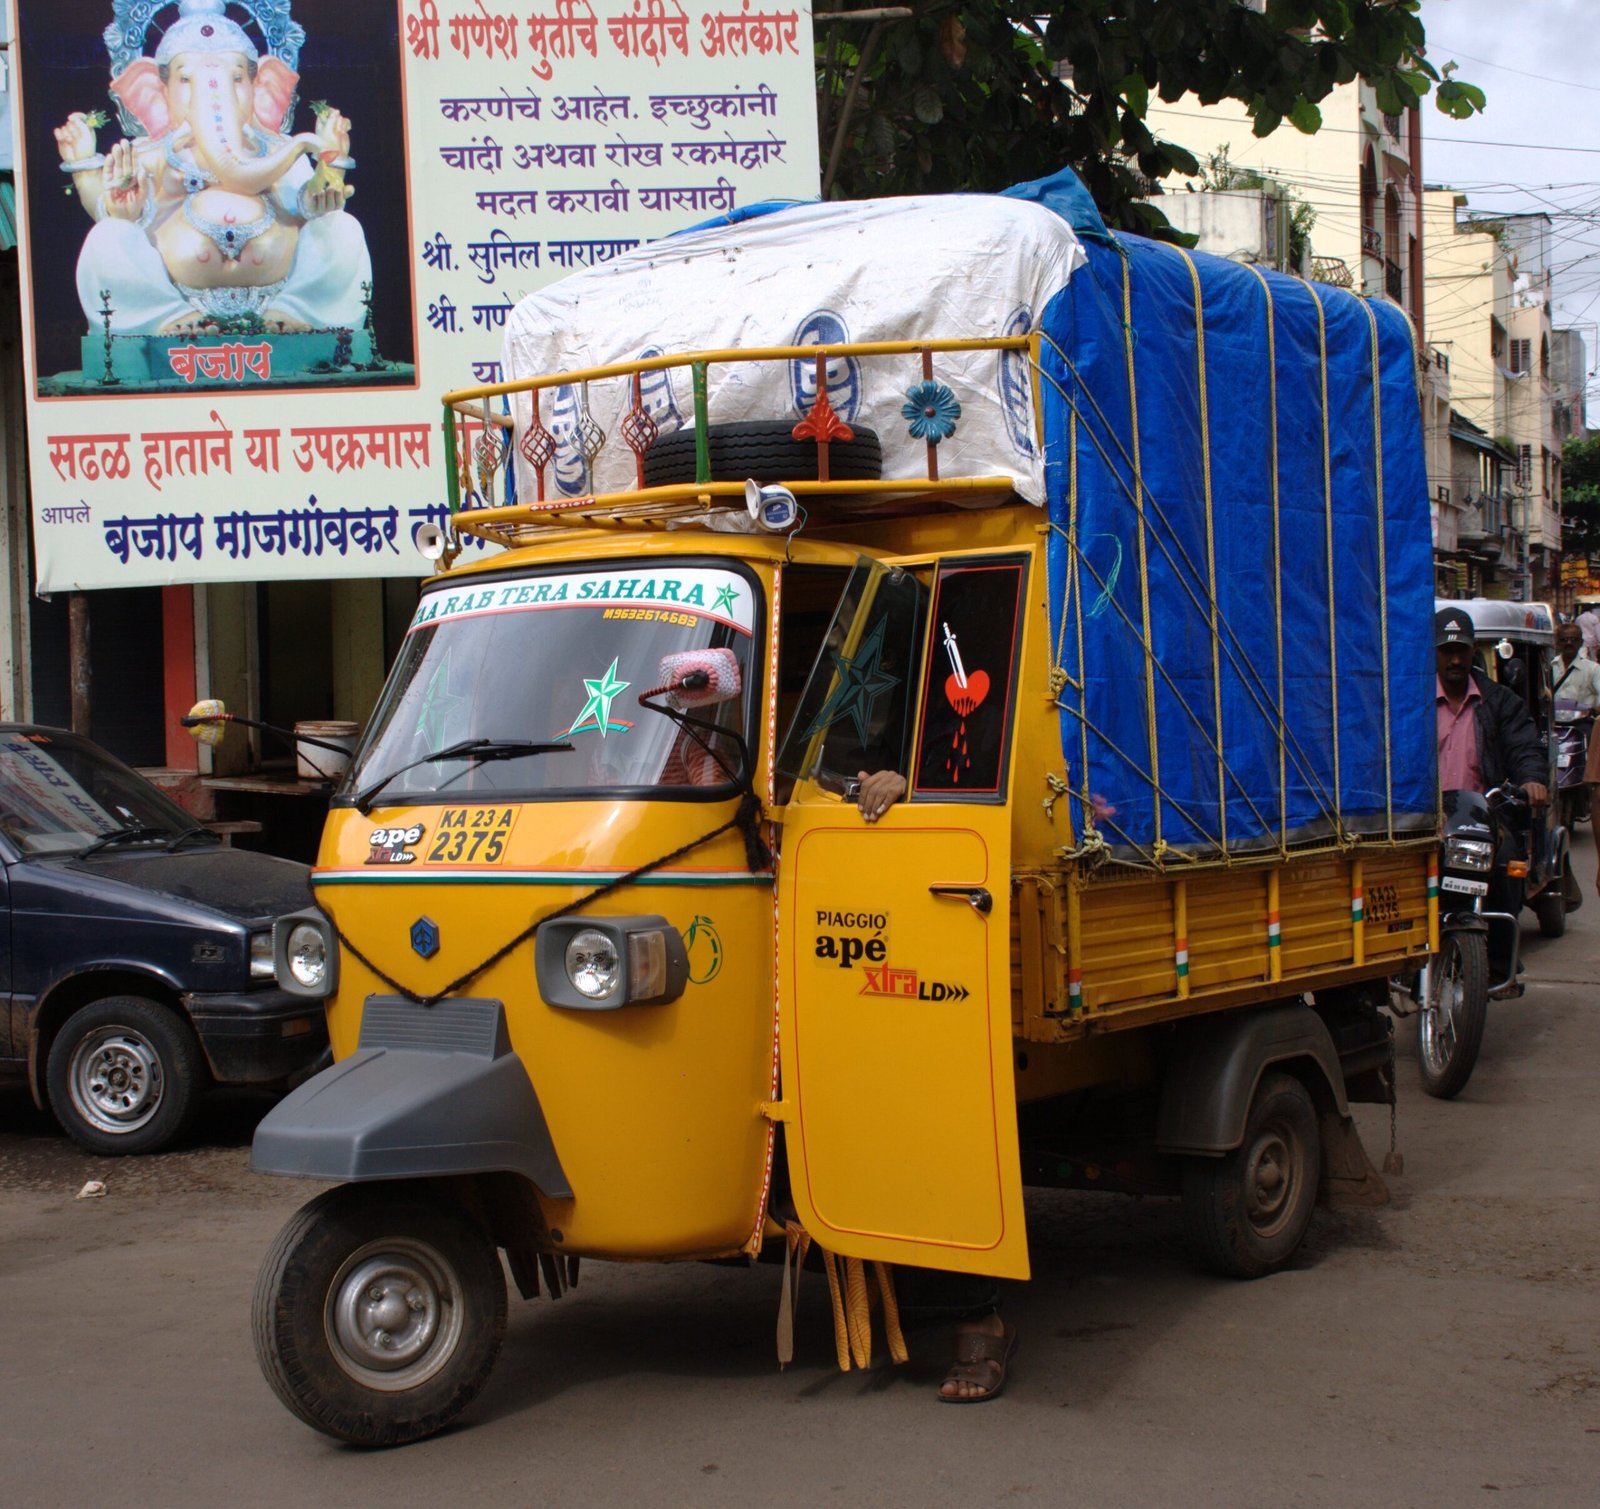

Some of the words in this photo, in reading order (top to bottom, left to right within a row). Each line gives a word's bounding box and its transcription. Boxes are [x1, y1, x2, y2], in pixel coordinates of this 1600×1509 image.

[407, 0, 439, 59] श्री
[449, 0, 518, 60] गणेश
[701, 0, 799, 57] अलंकार
[440, 87, 541, 121] करणेचे
[552, 86, 638, 123] आहेत.
[649, 83, 777, 130] इच्छुकांनी
[440, 136, 503, 174] चांदी
[513, 144, 596, 169] अथवा
[605, 133, 663, 167] रोख
[671, 126, 786, 169] रकमेद्वारे
[476, 191, 538, 219] मदत
[546, 179, 630, 213] करावी
[638, 177, 736, 212] यासाठी
[422, 232, 459, 270] श्री.
[468, 229, 540, 284] सुनिल
[427, 294, 463, 333] श्री.
[48, 434, 130, 481] सढळ
[141, 411, 233, 491] हाताने
[244, 429, 280, 472] या
[291, 424, 431, 473] उपक्रमास
[42, 500, 91, 523] आपले
[103, 513, 204, 564] बजाप
[441, 590, 495, 615] RAB
[499, 582, 569, 606] TERA
[576, 579, 706, 606] SAHARA
[440, 810, 467, 828] KA
[471, 809, 496, 827] 23
[498, 808, 512, 827] A
[428, 831, 507, 862] 2375
[816, 911, 887, 929] PIAGGIO
[815, 931, 887, 968] apé
